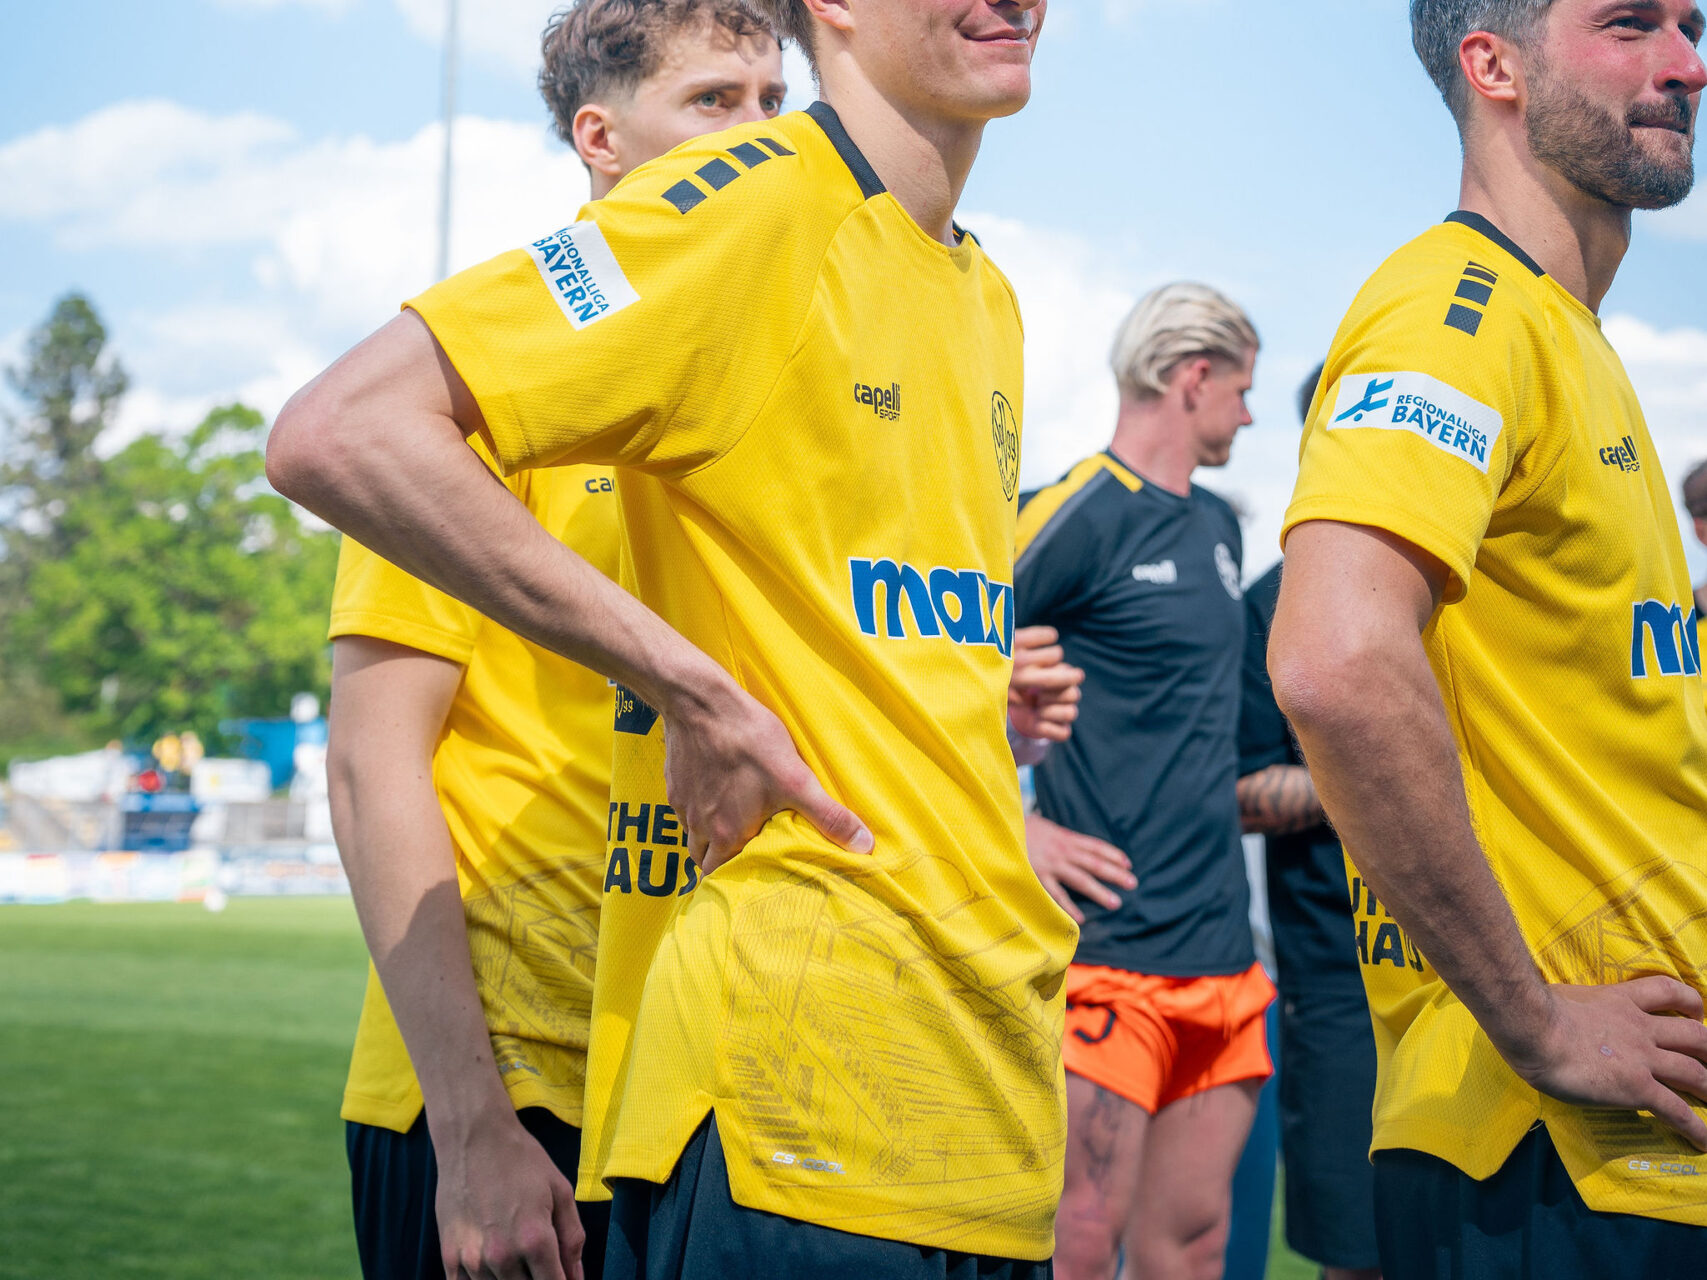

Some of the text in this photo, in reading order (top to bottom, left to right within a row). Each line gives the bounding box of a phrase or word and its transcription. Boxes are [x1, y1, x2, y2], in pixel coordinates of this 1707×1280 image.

[532, 236, 600, 322] BAYERN
[555, 228, 610, 313] GIONALLIGA
[854, 381, 900, 414] capelli
[1396, 394, 1488, 446] REGIONALLIGA
[1391, 405, 1487, 464] BAYERN
[585, 477, 615, 494] ca
